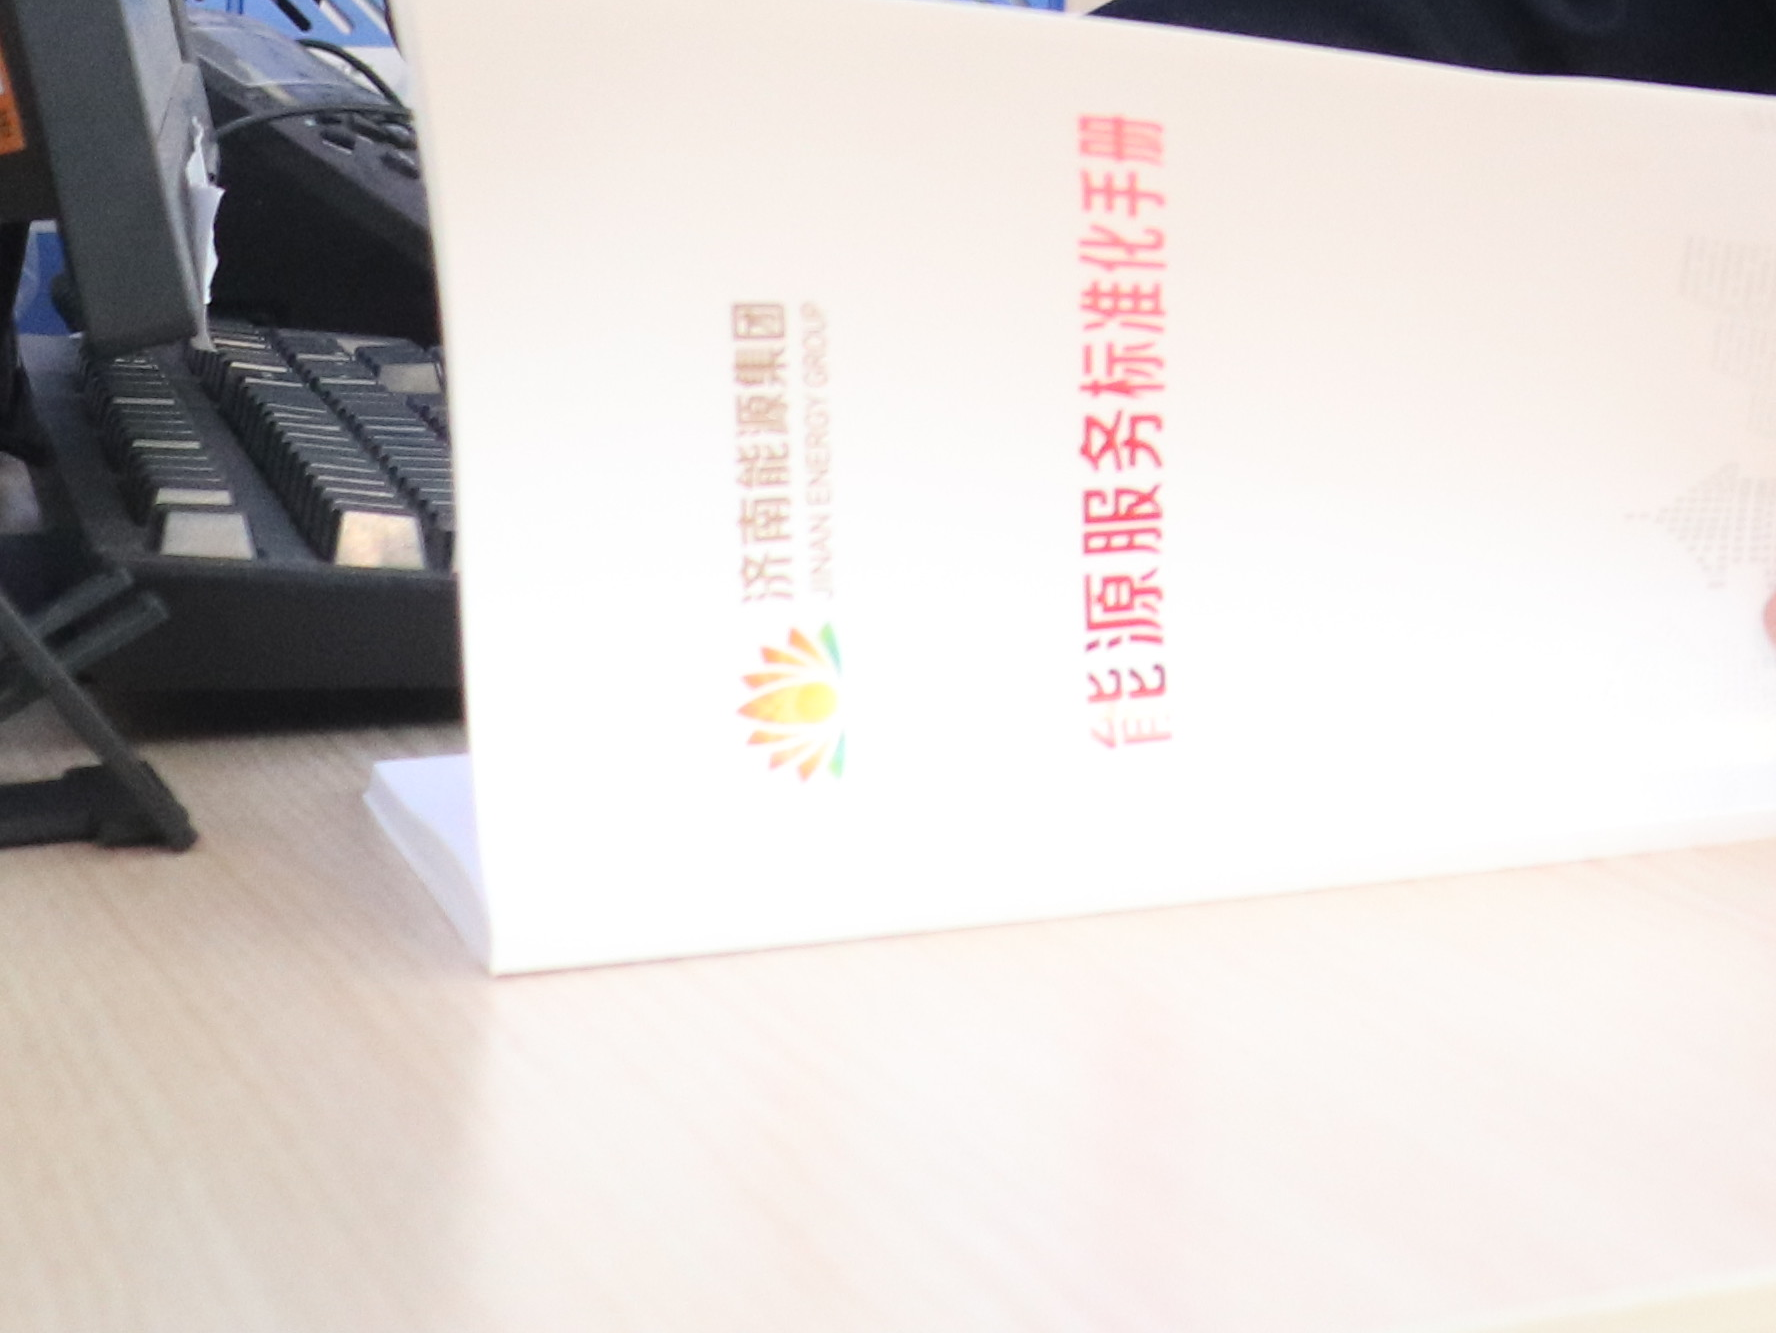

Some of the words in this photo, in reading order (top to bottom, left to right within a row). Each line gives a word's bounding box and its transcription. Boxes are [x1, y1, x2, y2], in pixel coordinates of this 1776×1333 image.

[800, 303, 831, 389] GROUP
[732, 303, 793, 603] 济南能源集团
[804, 395, 834, 508] ENERGY
[1079, 116, 1170, 747] 能源服务标准化手册
[808, 513, 835, 598] JINAN
